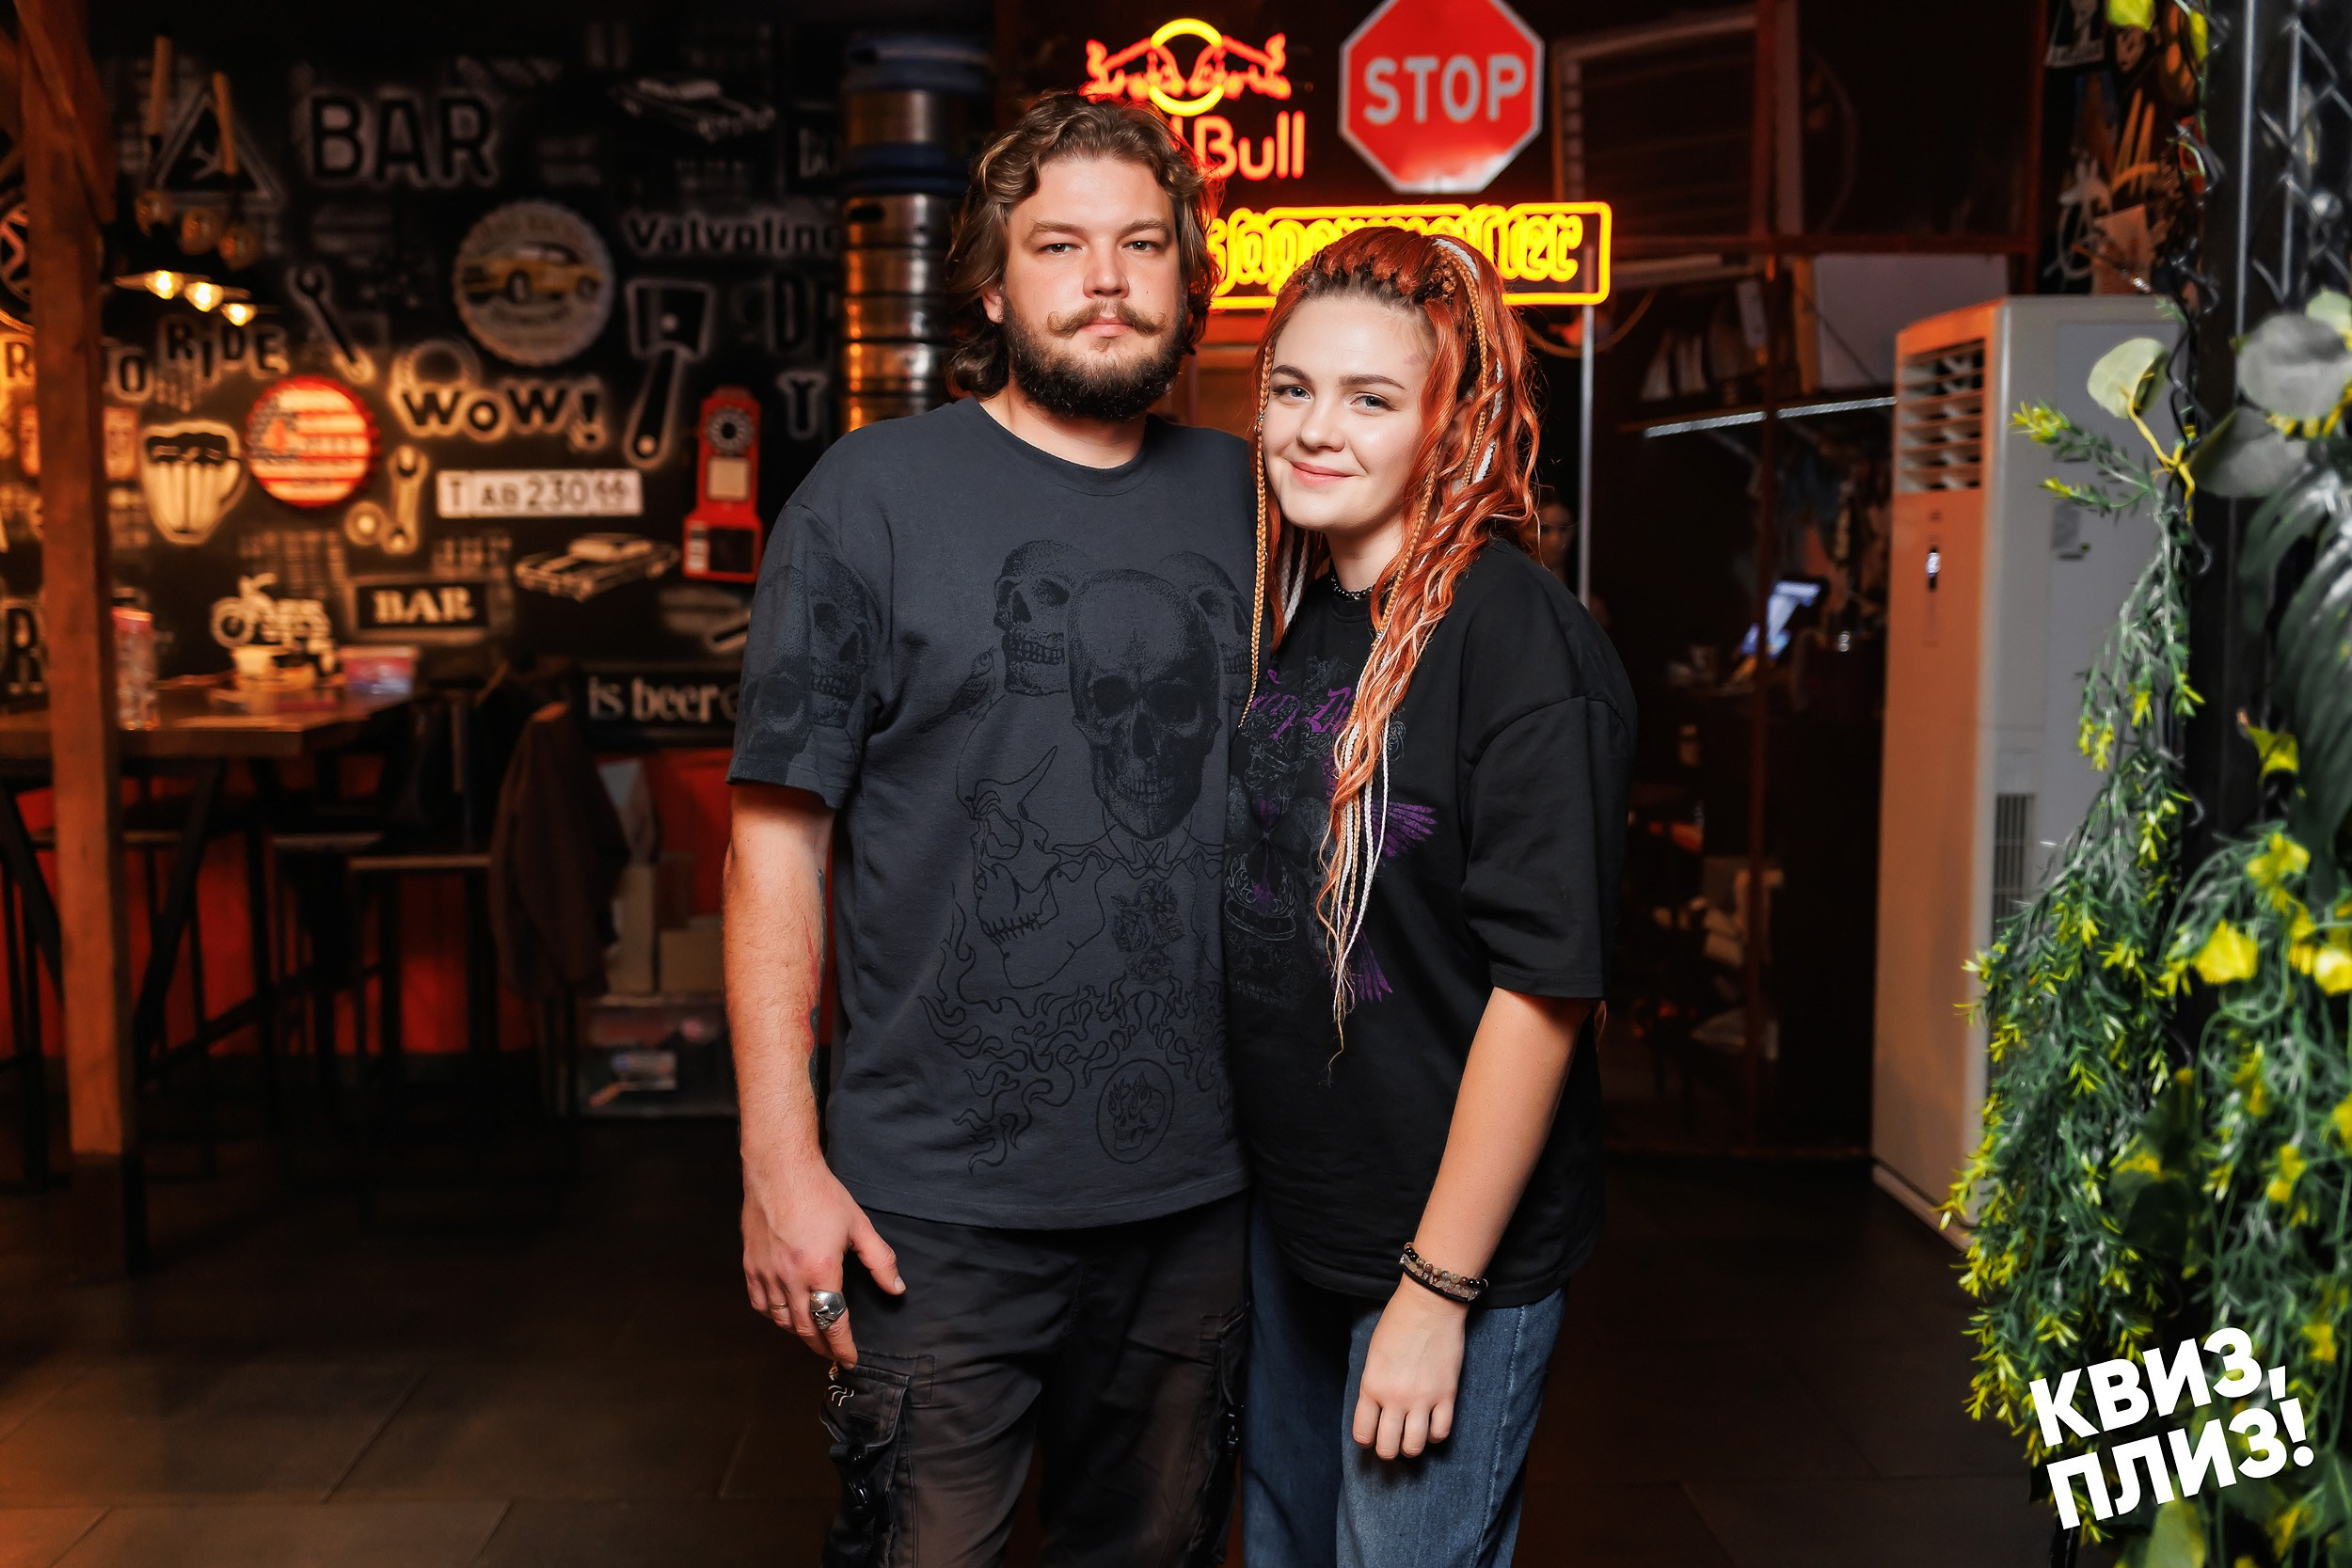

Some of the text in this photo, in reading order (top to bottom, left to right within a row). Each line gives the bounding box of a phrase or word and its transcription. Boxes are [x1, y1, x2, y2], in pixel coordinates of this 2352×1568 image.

[1363, 55, 1526, 124] STOP
[312, 97, 489, 182] BAR
[1193, 110, 1306, 182] Bull
[167, 320, 278, 377] RIDE
[373, 585, 475, 624] BAR
[588, 674, 625, 721] is
[631, 675, 719, 723] beer
